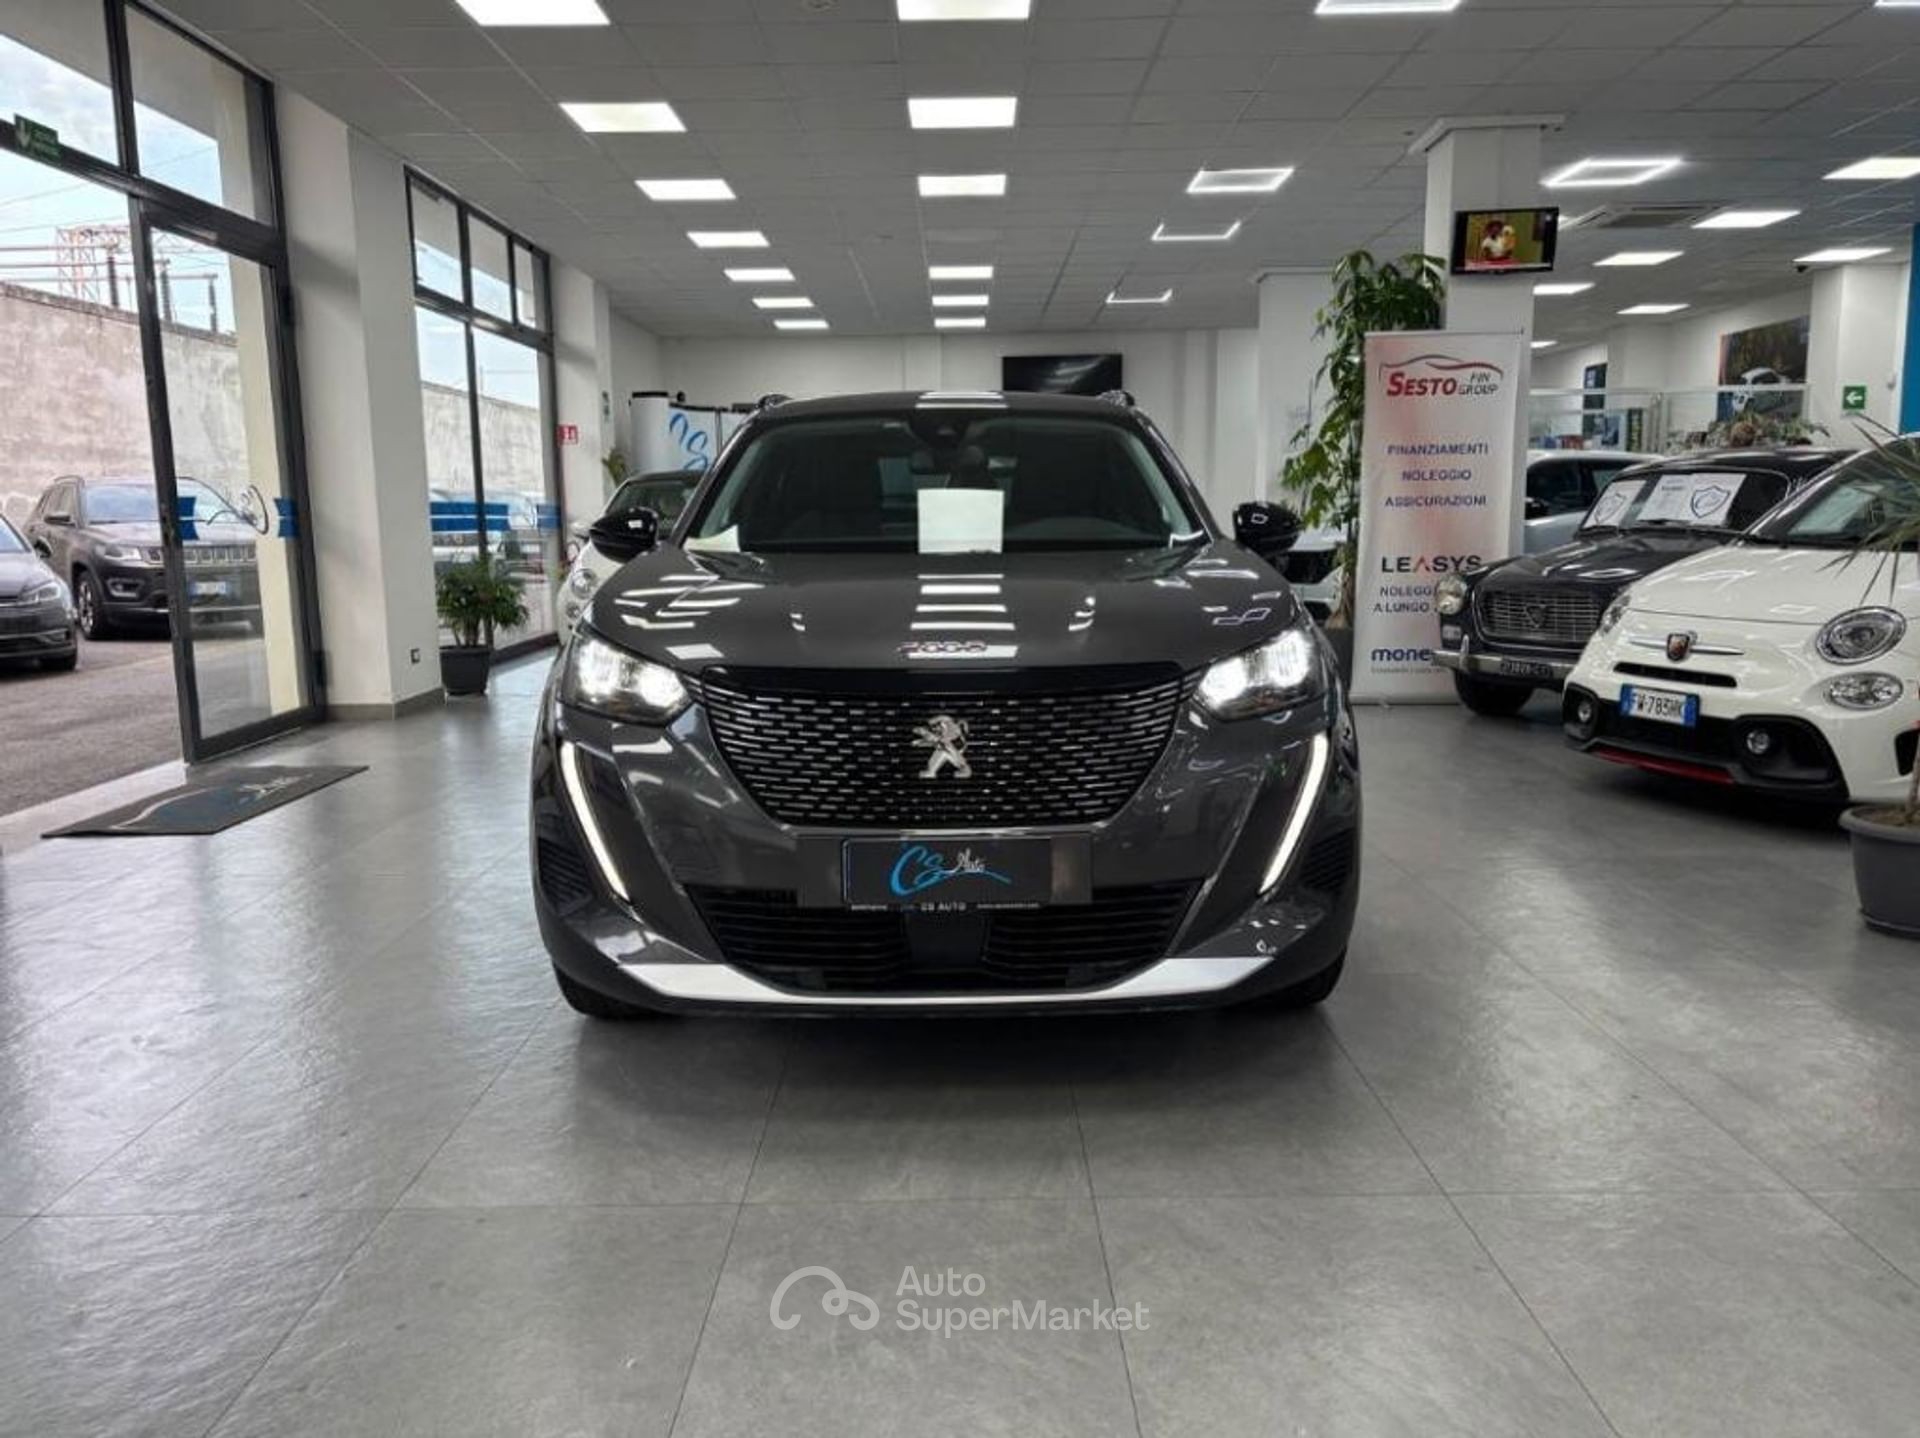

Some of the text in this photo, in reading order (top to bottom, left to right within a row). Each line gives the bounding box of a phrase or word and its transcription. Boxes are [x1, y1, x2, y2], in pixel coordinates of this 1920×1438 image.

[1386, 371, 1457, 397] SESTO
[1387, 442, 1488, 455] FINANZIAMENTI
[1402, 469, 1472, 481] NOLEGGIO
[1384, 495, 1487, 507] ASSICURAZIONI
[1382, 555, 1482, 573] LEASYS
[1371, 648, 1433, 662] mone
